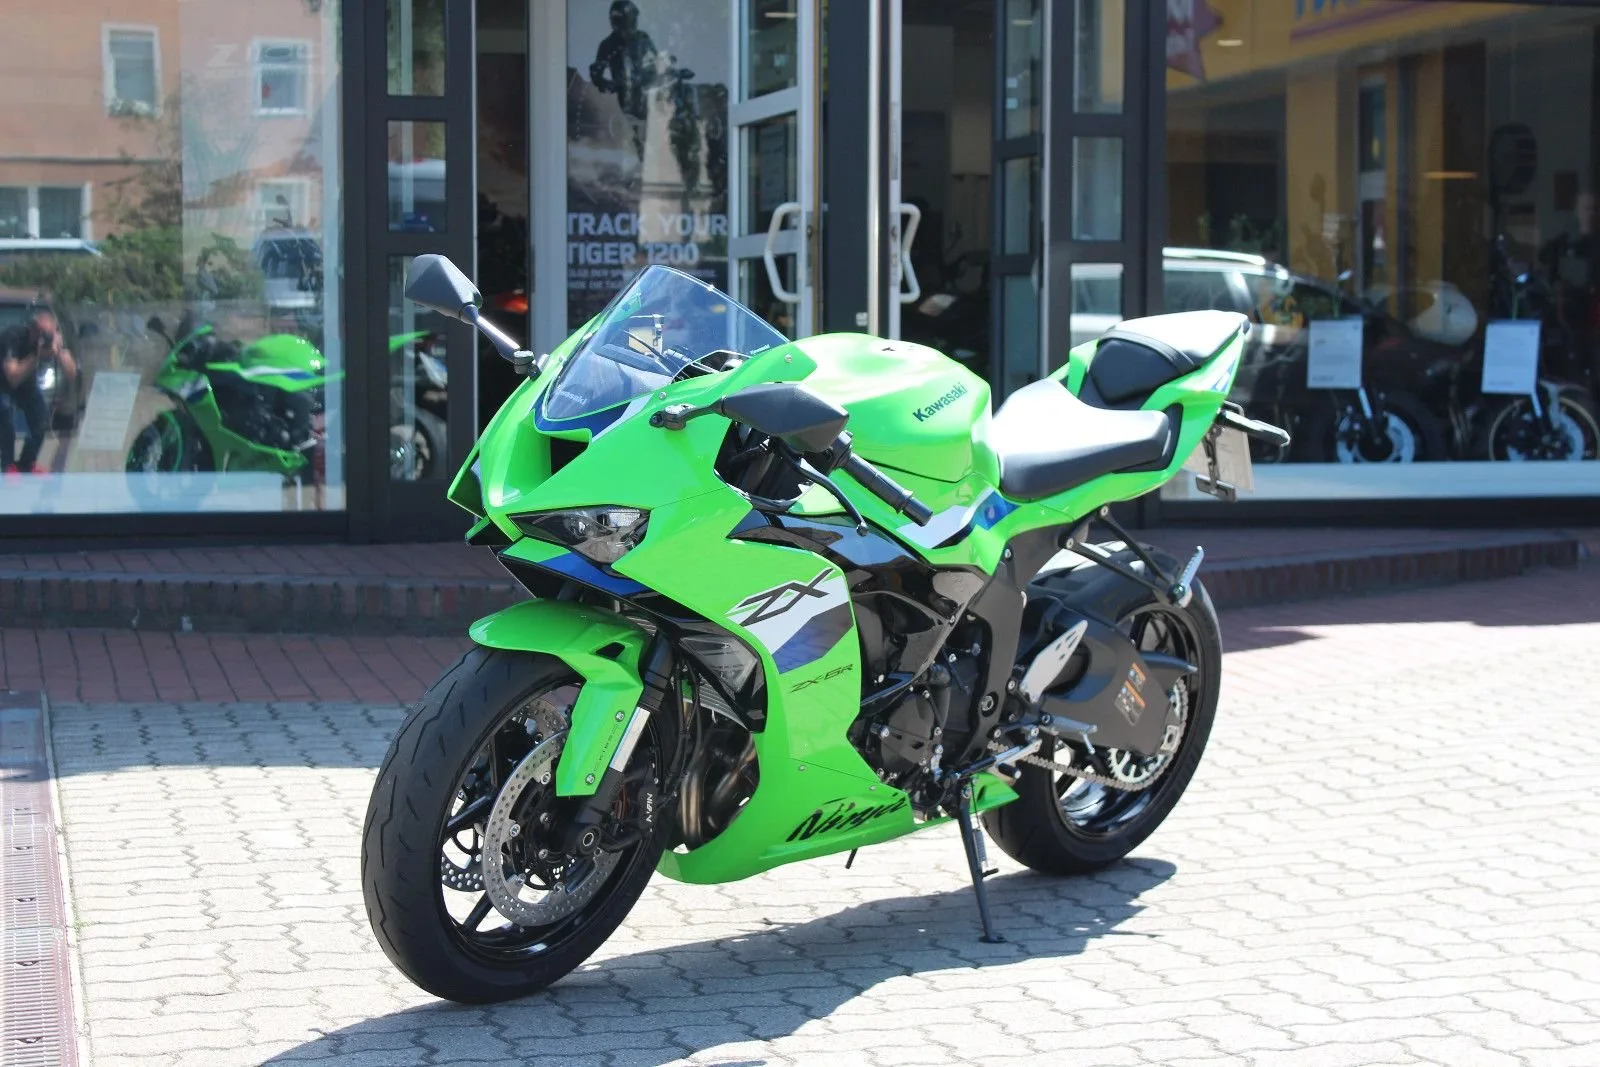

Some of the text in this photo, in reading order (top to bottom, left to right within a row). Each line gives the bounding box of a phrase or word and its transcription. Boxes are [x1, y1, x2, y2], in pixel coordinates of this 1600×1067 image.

[567, 213, 729, 236] TRACK YOUR
[567, 242, 699, 265] TIGER 1200
[912, 382, 968, 422] Kawasaki
[735, 567, 834, 628] ZX
[785, 792, 908, 842] Ninja
